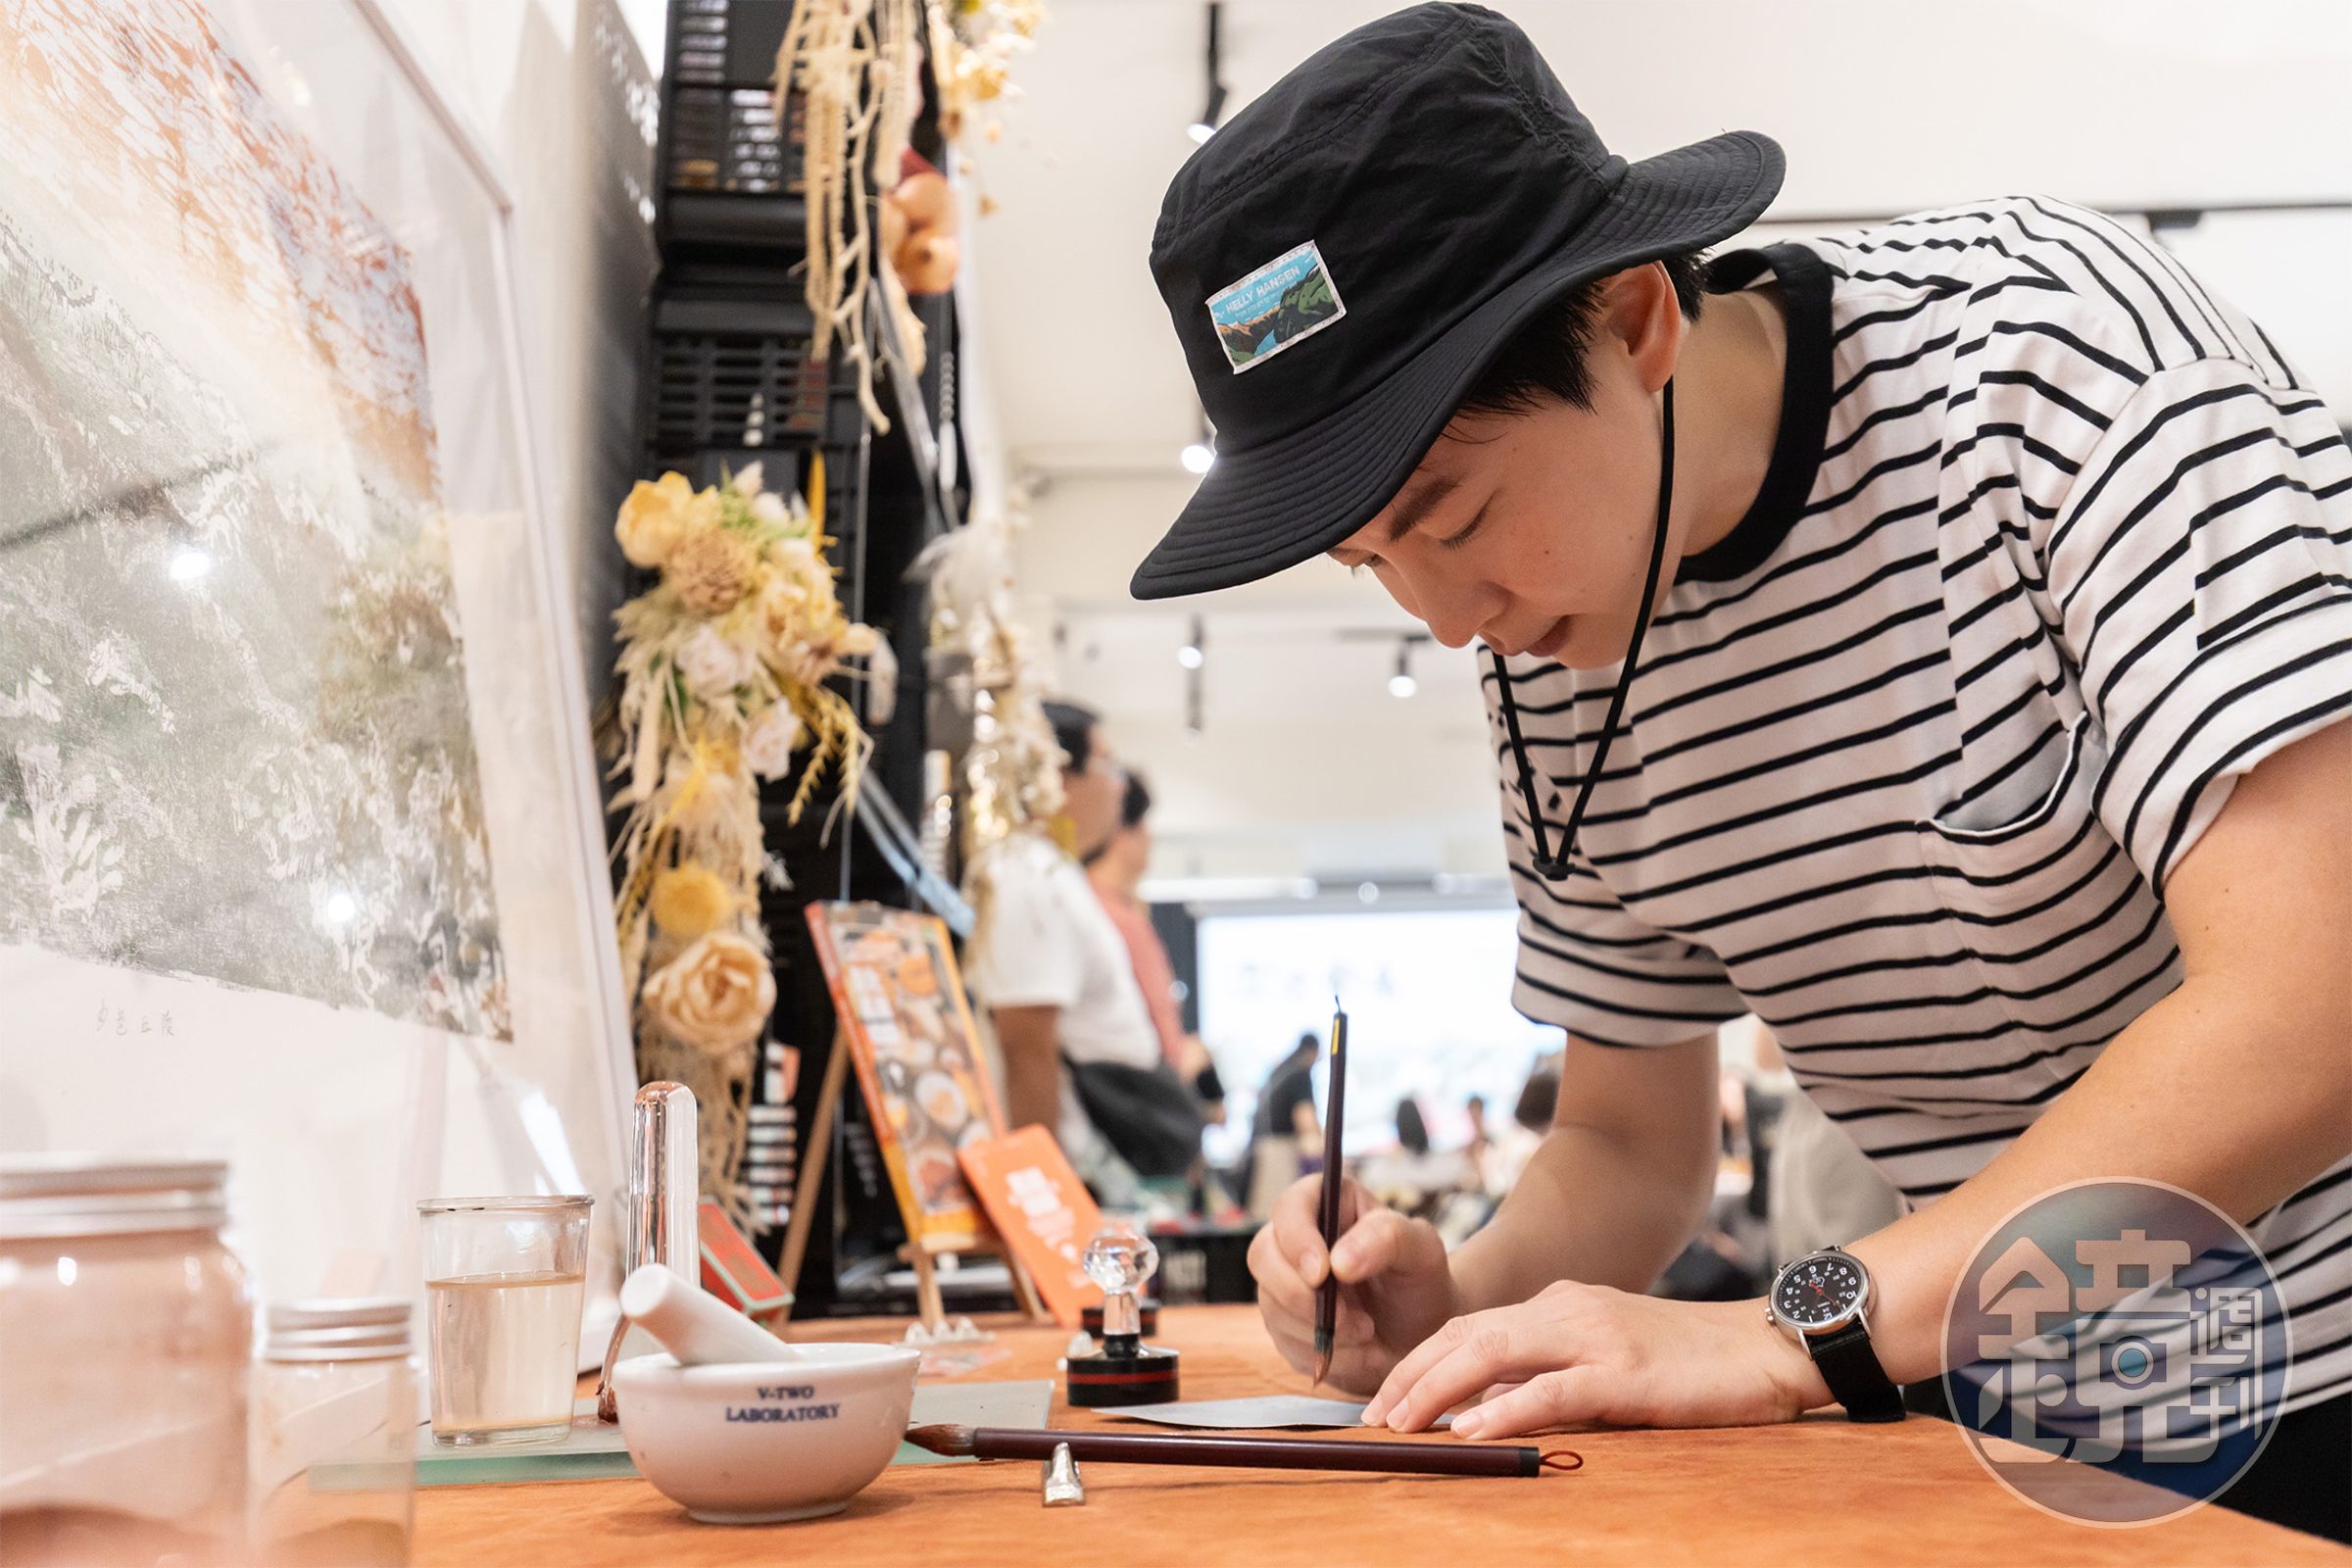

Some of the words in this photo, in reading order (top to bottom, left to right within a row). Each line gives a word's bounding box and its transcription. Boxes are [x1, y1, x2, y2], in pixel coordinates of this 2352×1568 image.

[1225, 289, 1254, 314] HELLY
[1255, 266, 1301, 298] HANSEN
[1808, 1265, 1817, 1274] 6
[1827, 1262, 1835, 1272] 7
[1838, 1266, 1848, 1276] 8
[1793, 1274, 1801, 1284] 5
[1847, 1276, 1857, 1286] 9
[1786, 1287, 1793, 1296] 4
[1846, 1290, 1858, 1299] 10
[1784, 1300, 1791, 1309] 3
[1792, 1310, 1800, 1319] 2
[756, 1385, 815, 1400] V-TWO
[725, 1402, 841, 1423] LABORATORY
